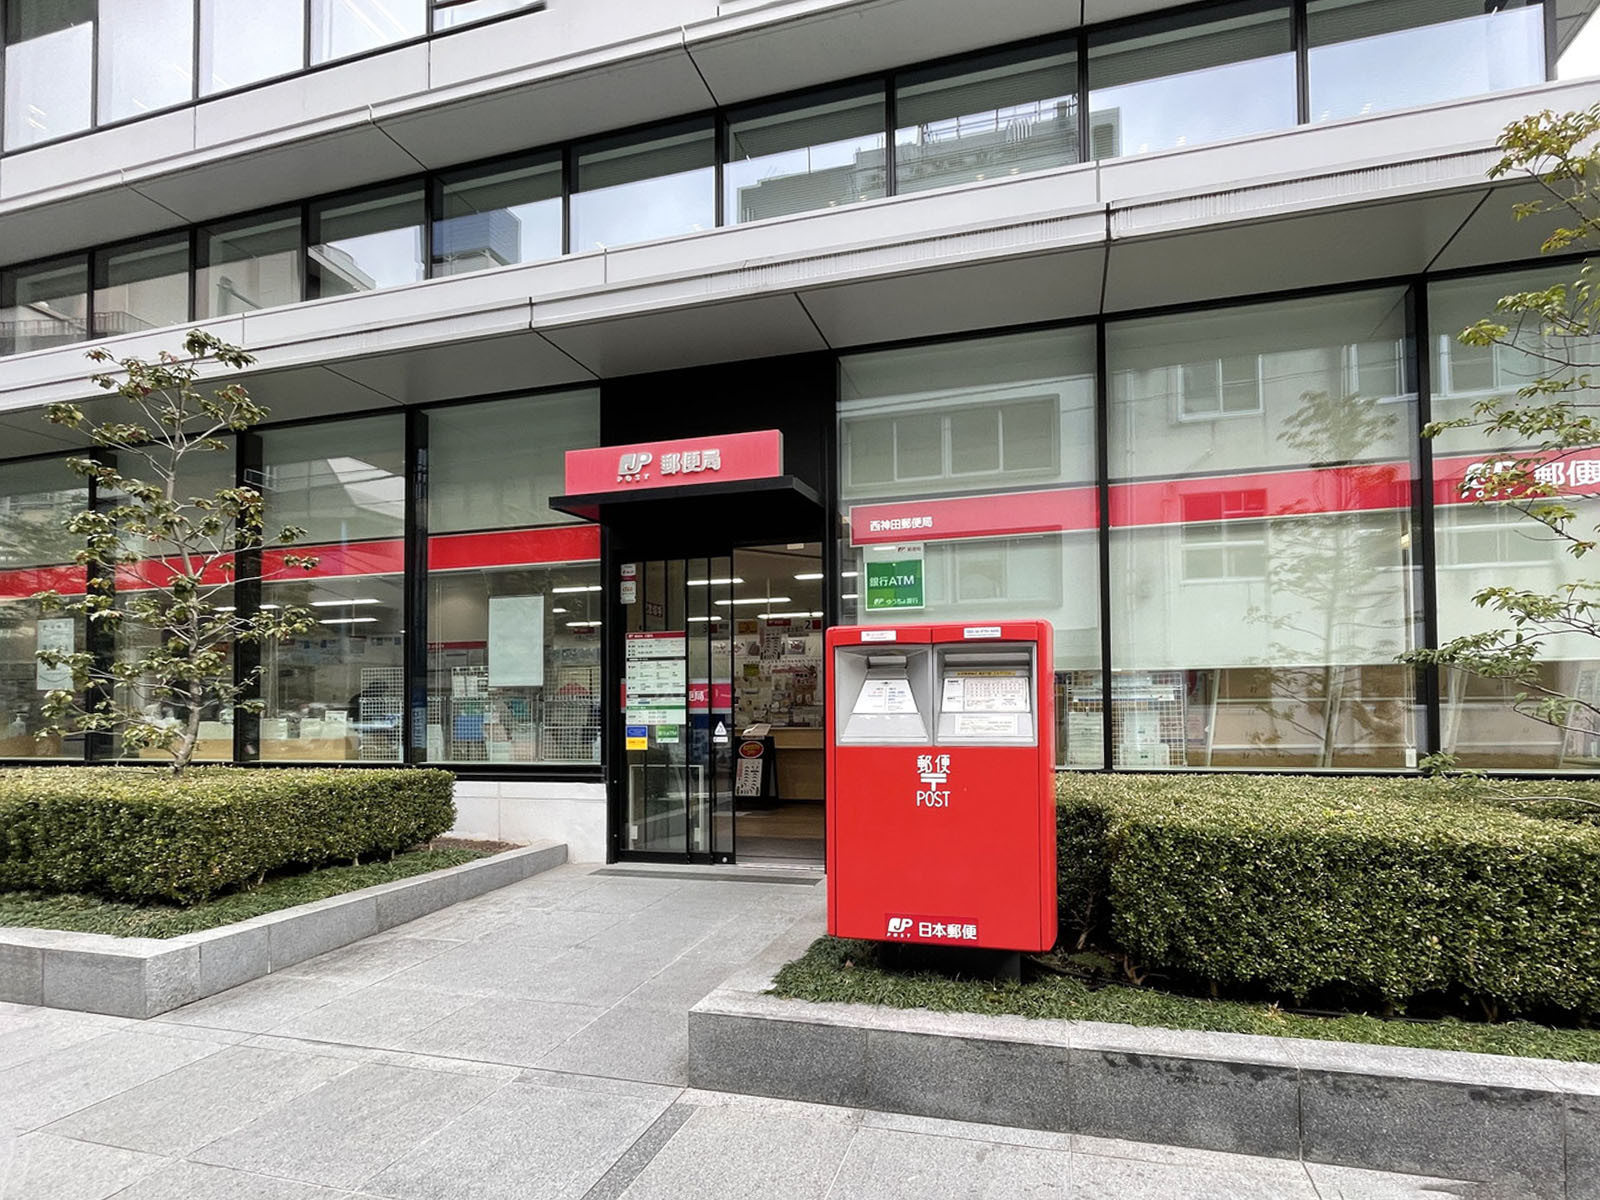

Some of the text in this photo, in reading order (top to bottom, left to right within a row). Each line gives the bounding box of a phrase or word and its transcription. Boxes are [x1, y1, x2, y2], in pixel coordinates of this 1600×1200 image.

[660, 449, 721, 475] 郵便局
[869, 516, 933, 532] 西神田郵便局
[870, 575, 914, 587] 銀行ATM
[917, 754, 951, 774] 郵便
[916, 790, 951, 807] POST
[919, 922, 977, 940] 日本郵便
